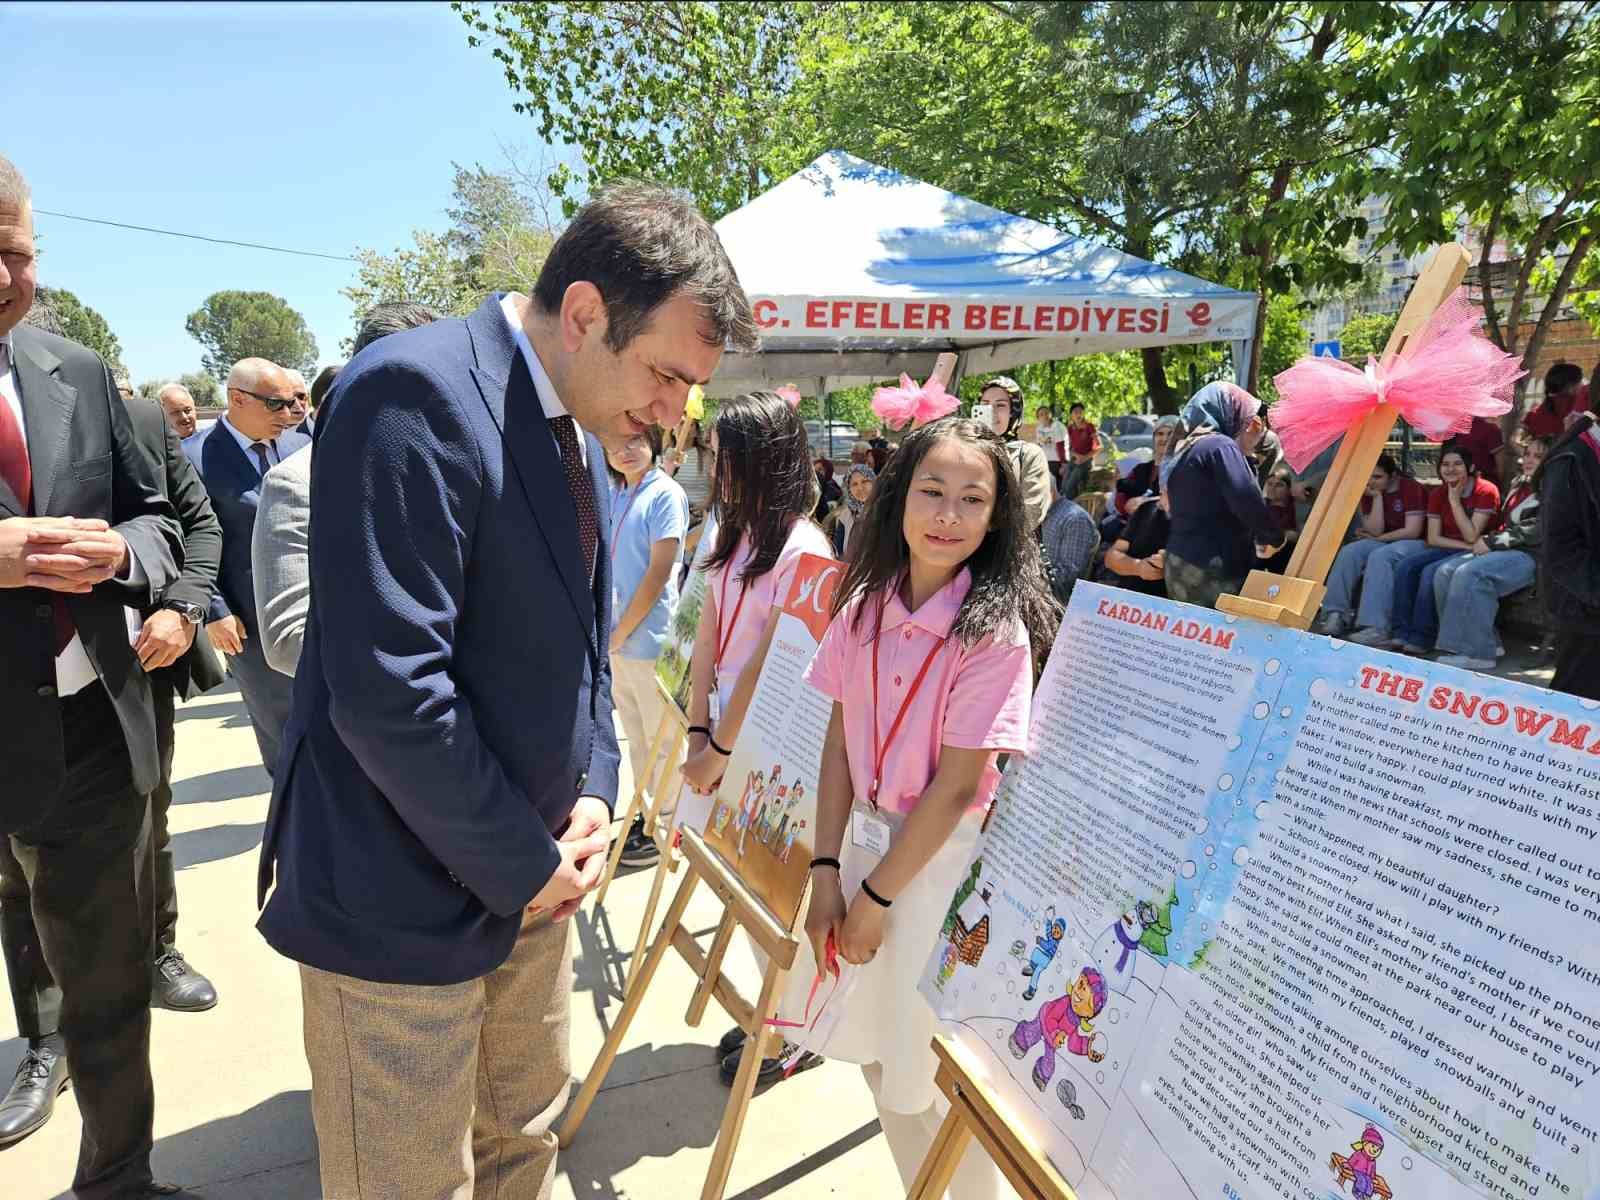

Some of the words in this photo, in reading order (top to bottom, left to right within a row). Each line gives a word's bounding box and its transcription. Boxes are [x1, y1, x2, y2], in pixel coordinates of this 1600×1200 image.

[805, 301, 950, 330] EFELER
[964, 300, 1169, 334] BELEDİYESİ
[1097, 600, 1168, 631] KARDAN
[1170, 620, 1234, 649] ADAM
[1327, 704, 1359, 720] mother
[1360, 717, 1389, 731] called
[1390, 725, 1406, 737] me
[1408, 731, 1420, 741] to
[1422, 735, 1440, 748] the
[1442, 742, 1484, 761] kitchen
[1487, 755, 1500, 767] to
[1503, 760, 1533, 778] have
[1356, 701, 1386, 716] woken
[1389, 709, 1401, 720] up
[1403, 714, 1432, 728] early
[1432, 720, 1442, 732] in
[1445, 726, 1464, 737] the
[1467, 734, 1517, 756] morning
[1520, 750, 1544, 763] and
[1548, 758, 1572, 772] was
[1360, 667, 1423, 702] THE
[1296, 740, 1323, 755] school
[1324, 750, 1341, 762] and
[1343, 756, 1367, 772] build
[1375, 771, 1426, 795] snowman.
[1305, 714, 1321, 723] out
[1322, 719, 1336, 730] the
[1379, 739, 1439, 765] everywhere
[1441, 757, 1464, 772] had
[1465, 767, 1506, 787] turned
[1509, 781, 1548, 802] white.
[1552, 795, 1563, 807] It
[1566, 802, 1593, 817] was
[1307, 758, 1332, 774] While
[1340, 774, 1357, 784] was
[1359, 779, 1390, 799] having
[1446, 814, 1465, 828] my
[1467, 822, 1515, 846] mother
[1517, 841, 1557, 864] called
[1560, 859, 1584, 874] out
[1335, 740, 1352, 751] was
[1354, 745, 1377, 759] very
[1418, 770, 1449, 786] could
[1450, 779, 1474, 794] play
[1476, 789, 1539, 818] snowballs
[1542, 812, 1572, 830] with
[1575, 825, 1598, 840] my
[1280, 840, 1300, 856] build
[1309, 856, 1359, 885] snowman?
[1283, 782, 1309, 797] heard
[1320, 794, 1346, 812] When
[1347, 808, 1361, 820] my
[1363, 814, 1399, 835] mother
[1402, 831, 1423, 845] saw
[1425, 841, 1443, 855] my
[1444, 849, 1496, 879] sadness,
[1500, 872, 1522, 888] she
[1526, 884, 1561, 905] came
[1565, 899, 1579, 912] to
[1294, 815, 1317, 832] What
[1368, 850, 1384, 864] my
[1385, 858, 1435, 887] beautiful
[1437, 882, 1500, 916] daughter?
[1310, 775, 1328, 789] said
[1329, 784, 1341, 793] on
[1343, 789, 1358, 800] the
[1360, 797, 1385, 812] news
[1387, 806, 1409, 822] that
[1410, 817, 1450, 839] schools
[1453, 834, 1484, 853] were
[1487, 848, 1531, 873] closed.
[1545, 872, 1569, 889] was
[1248, 856, 1272, 874] called
[1306, 888, 1334, 909] friend
[1355, 914, 1375, 931] She
[1376, 926, 1409, 949] asked
[1411, 944, 1429, 960] my
[1432, 953, 1476, 985] friend's
[1478, 981, 1527, 1012] mother
[1529, 1006, 1541, 1019] if
[1543, 1015, 1563, 1032] we
[1270, 850, 1292, 869] When
[1294, 863, 1307, 877] my
[1308, 873, 1343, 895] mother
[1345, 890, 1374, 911] heard
[1375, 907, 1402, 927] what
[1440, 941, 1461, 957] she
[1463, 953, 1506, 980] picked
[1508, 976, 1525, 991] up
[1528, 985, 1551, 1004] the
[1288, 828, 1321, 850] Schools
[1321, 846, 1337, 858] are
[1374, 869, 1398, 888] How
[1400, 883, 1421, 899] will
[1428, 896, 1454, 915] play
[1456, 911, 1483, 929] with
[1485, 924, 1506, 940] my
[1508, 934, 1564, 967] friends?
[1567, 961, 1600, 987] With
[1314, 926, 1342, 948] could
[1343, 943, 1370, 964] meet
[1371, 960, 1383, 972] at
[1385, 967, 1404, 984] the
[1405, 980, 1433, 1000] park
[1433, 996, 1463, 1017] near
[1464, 1013, 1487, 1031] our
[1489, 1026, 1529, 1055] house
[1532, 1052, 1547, 1067] to
[1550, 1063, 1584, 1089] play
[1381, 946, 1423, 976] mother
[1425, 971, 1449, 990] also
[1509, 1016, 1563, 1054] became
[1567, 1050, 1600, 1075] very
[1277, 1065, 1310, 1095] helped
[1306, 1031, 1332, 1052] child
[1332, 1047, 1357, 1071] from
[1360, 1067, 1377, 1085] the
[1380, 1082, 1463, 1144] neighborhood
[1465, 1139, 1508, 1176] kicked
[1510, 1173, 1539, 1197] and
[1318, 1057, 1349, 1085] friend
[1350, 1082, 1370, 1100] and
[1380, 1102, 1408, 1128] were
[1410, 1124, 1443, 1153] upset
[1446, 1150, 1472, 1172] and
[1324, 1025, 1360, 1055] among
[1361, 1050, 1412, 1089] ourselves
[1415, 1087, 1450, 1115] about
[1453, 1110, 1482, 1134] how
[1484, 1131, 1499, 1147] to
[1501, 1144, 1541, 1175] make
[1545, 1171, 1570, 1194] the
[1390, 1029, 1429, 1059] played
[1433, 1057, 1496, 1102] snowballs
[1498, 1098, 1526, 1120] and
[1532, 1117, 1567, 1146] built
[1425, 1031, 1474, 1066] dressed
[1475, 1062, 1524, 1099] warmly
[1527, 1094, 1556, 1117] and
[1559, 1111, 1599, 1143] went
